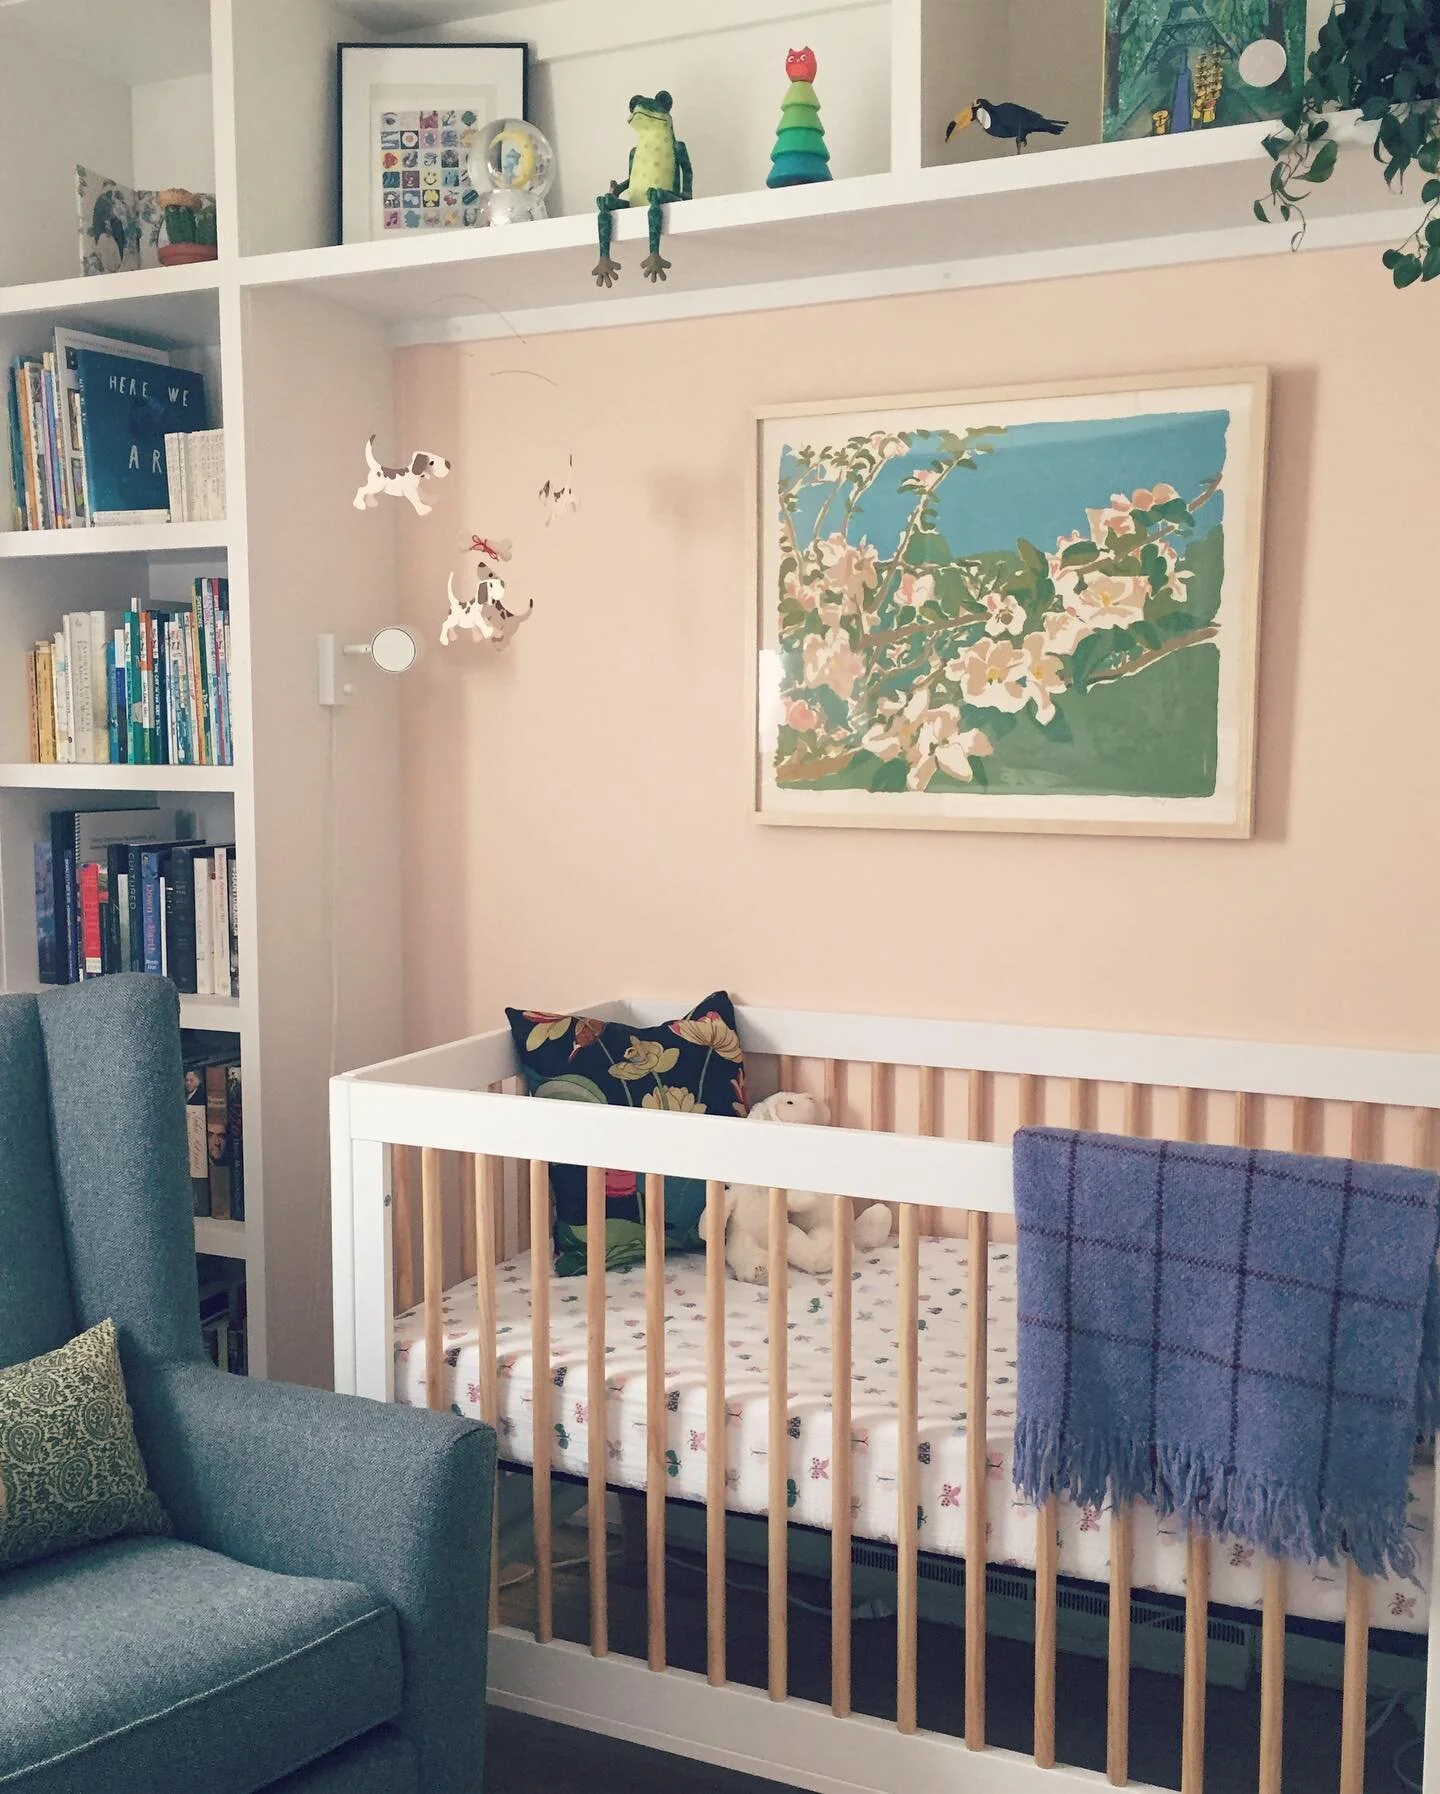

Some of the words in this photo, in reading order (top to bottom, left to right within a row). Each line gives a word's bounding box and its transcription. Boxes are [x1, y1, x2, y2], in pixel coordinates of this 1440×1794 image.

[109, 375, 149, 399] HERE
[168, 386, 188, 407] WE
[129, 445, 163, 474] AR
[128, 852, 136, 910] CULTURED
[146, 884, 154, 914] Down
